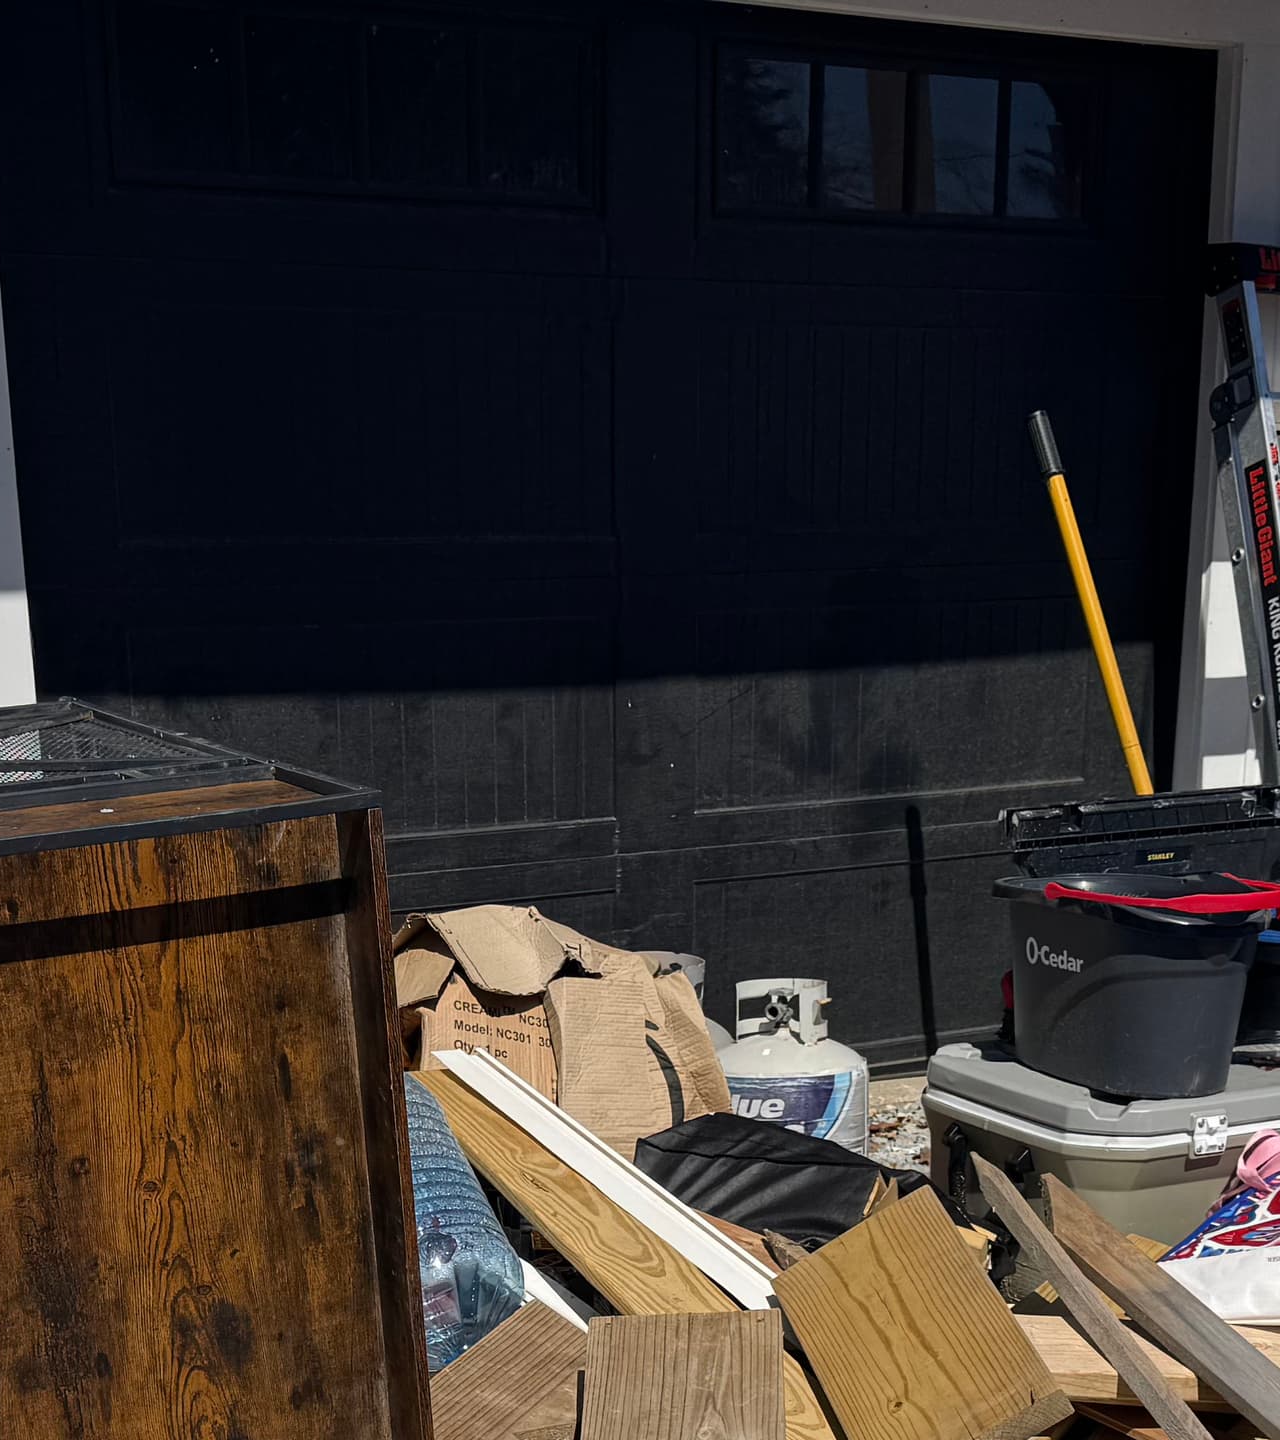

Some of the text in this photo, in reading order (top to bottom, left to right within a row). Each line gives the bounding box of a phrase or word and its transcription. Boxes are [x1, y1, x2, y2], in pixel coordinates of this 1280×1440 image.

[454, 1020, 493, 1036] Model:
[496, 1027, 531, 1044] NC301
[494, 1049, 508, 1059] pc
[731, 1094, 785, 1119] lue
